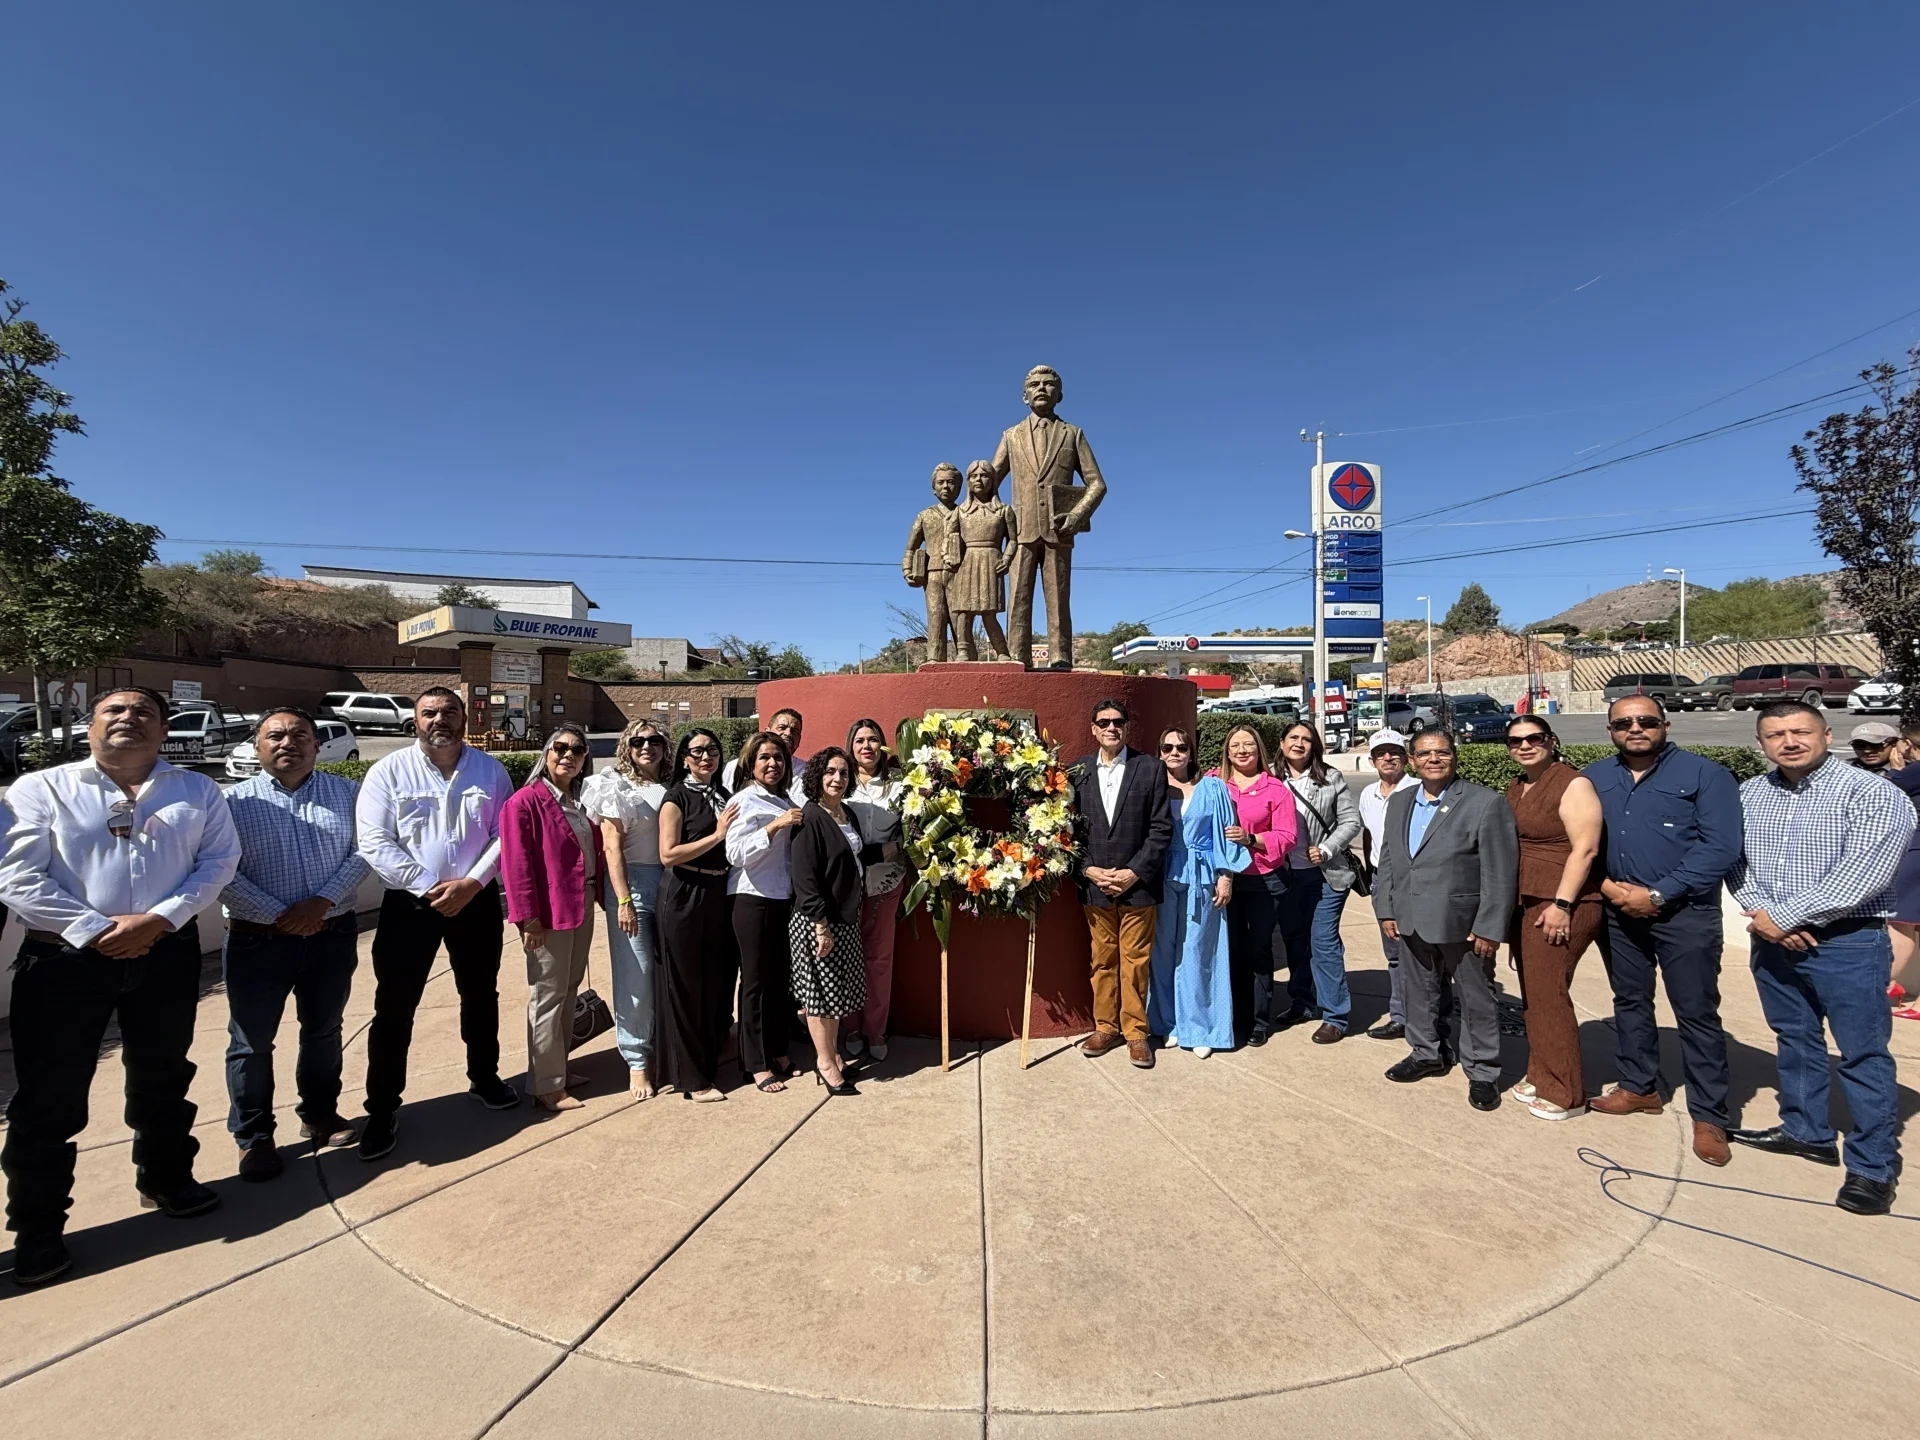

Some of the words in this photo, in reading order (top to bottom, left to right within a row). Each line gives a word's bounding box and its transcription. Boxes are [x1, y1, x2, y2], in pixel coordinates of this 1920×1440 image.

[1328, 515, 1376, 530] ARCO
[510, 619, 541, 633] BLUE
[543, 623, 599, 638] PROPANE
[1157, 639, 1183, 648] ARCO
[160, 742, 185, 752] LICÍA
